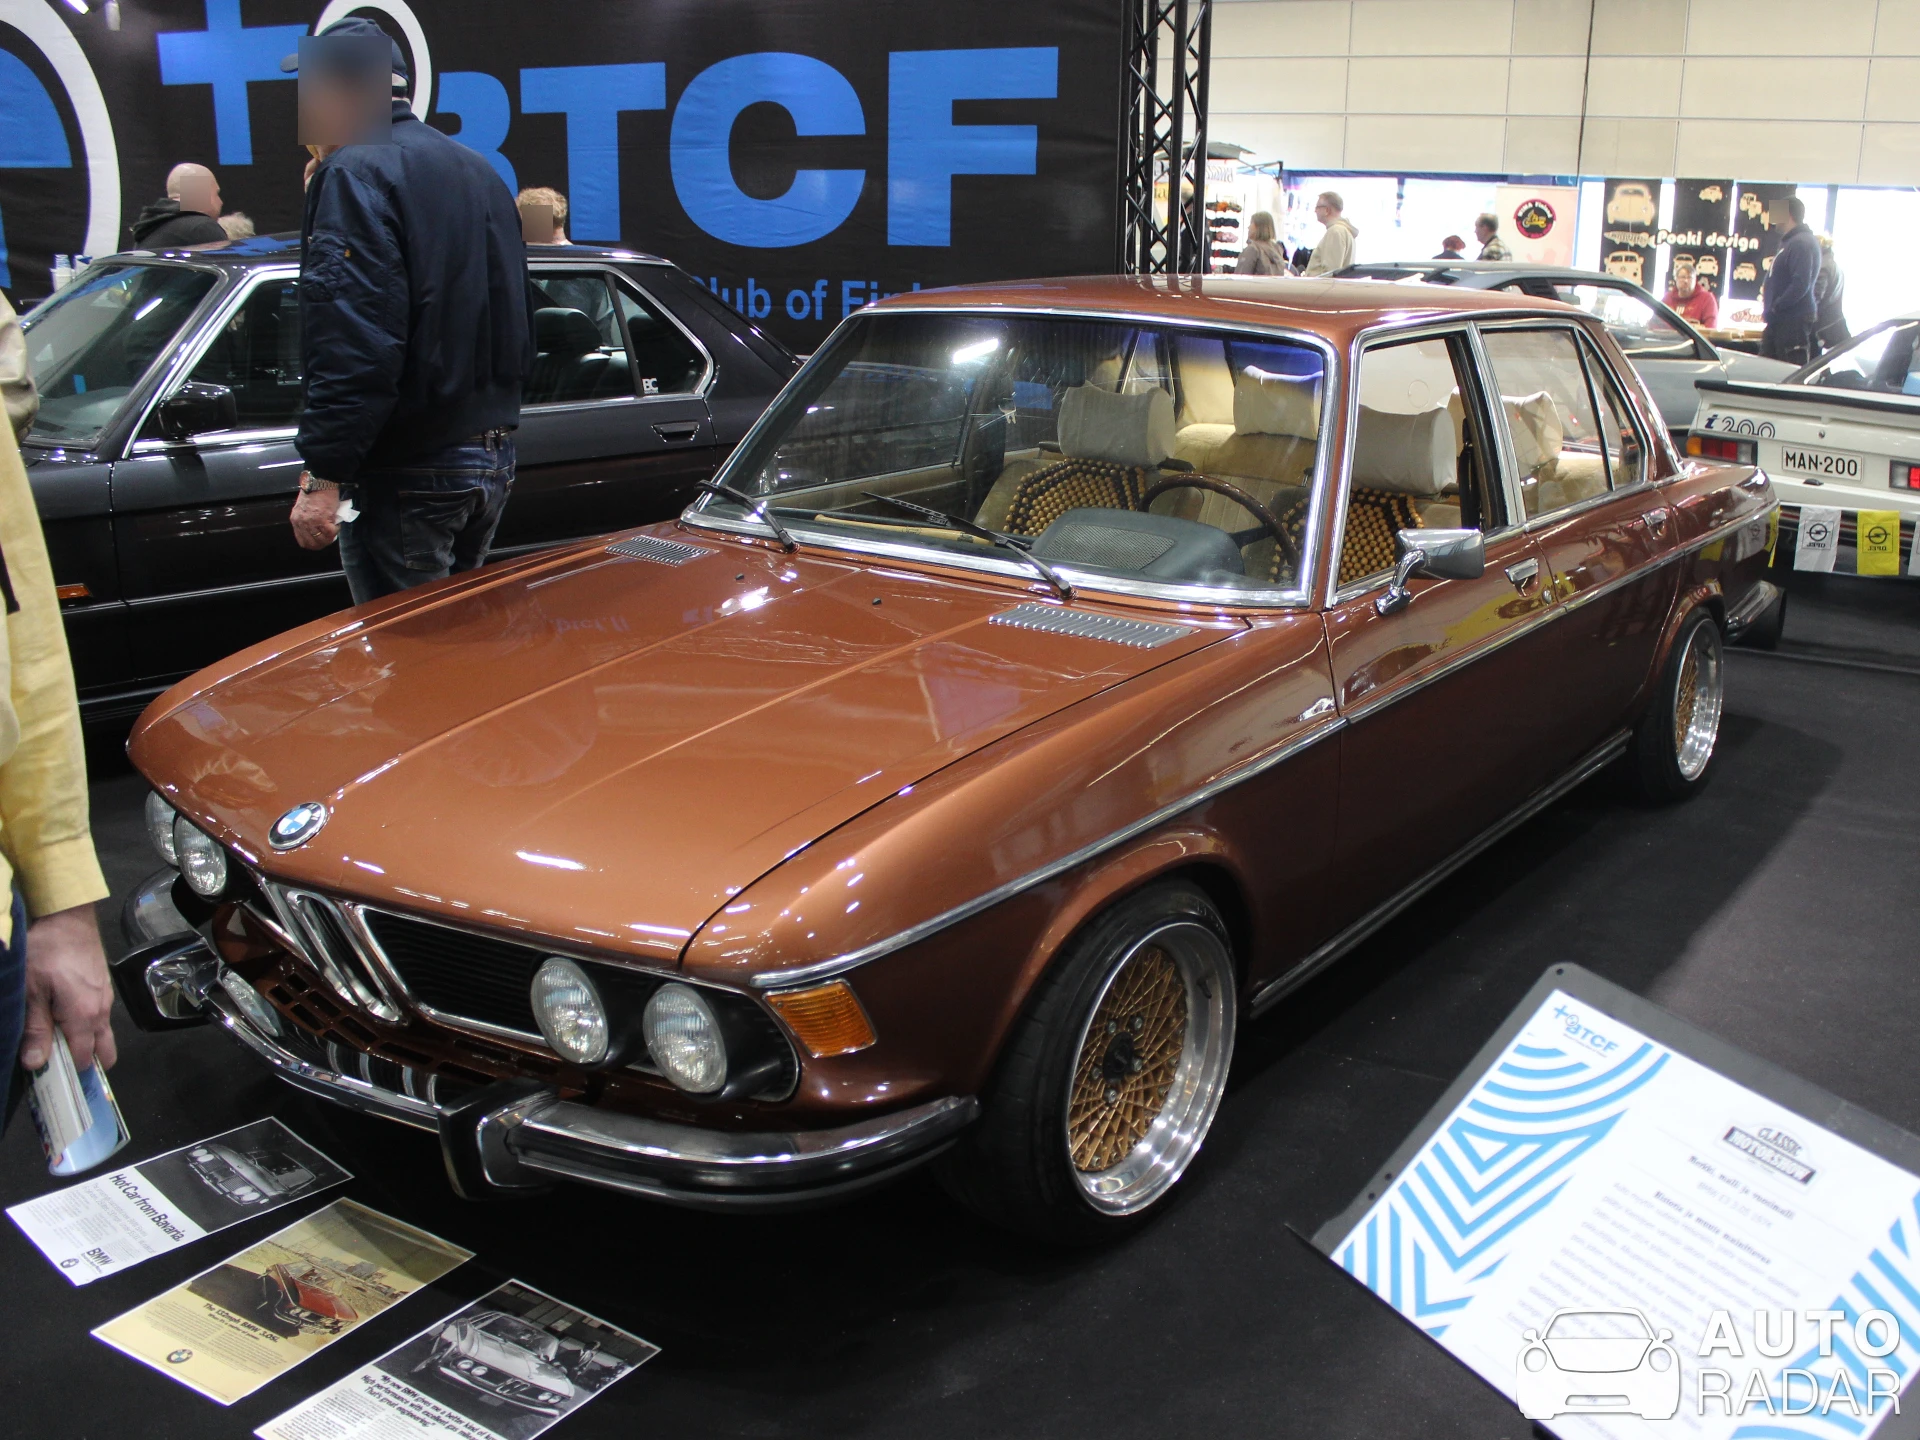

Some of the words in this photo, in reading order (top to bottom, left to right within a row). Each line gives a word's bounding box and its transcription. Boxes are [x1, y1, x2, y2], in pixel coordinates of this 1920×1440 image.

[1656, 229, 1702, 247] Pooki
[1705, 232, 1759, 252] design
[786, 280, 828, 320] of
[1784, 450, 1858, 477] MAN-200
[109, 1173, 127, 1190] Hot
[122, 1186, 142, 1202] Car
[134, 1198, 159, 1219] from
[151, 1213, 185, 1242] Bavaria.
[86, 1247, 114, 1267] BMW
